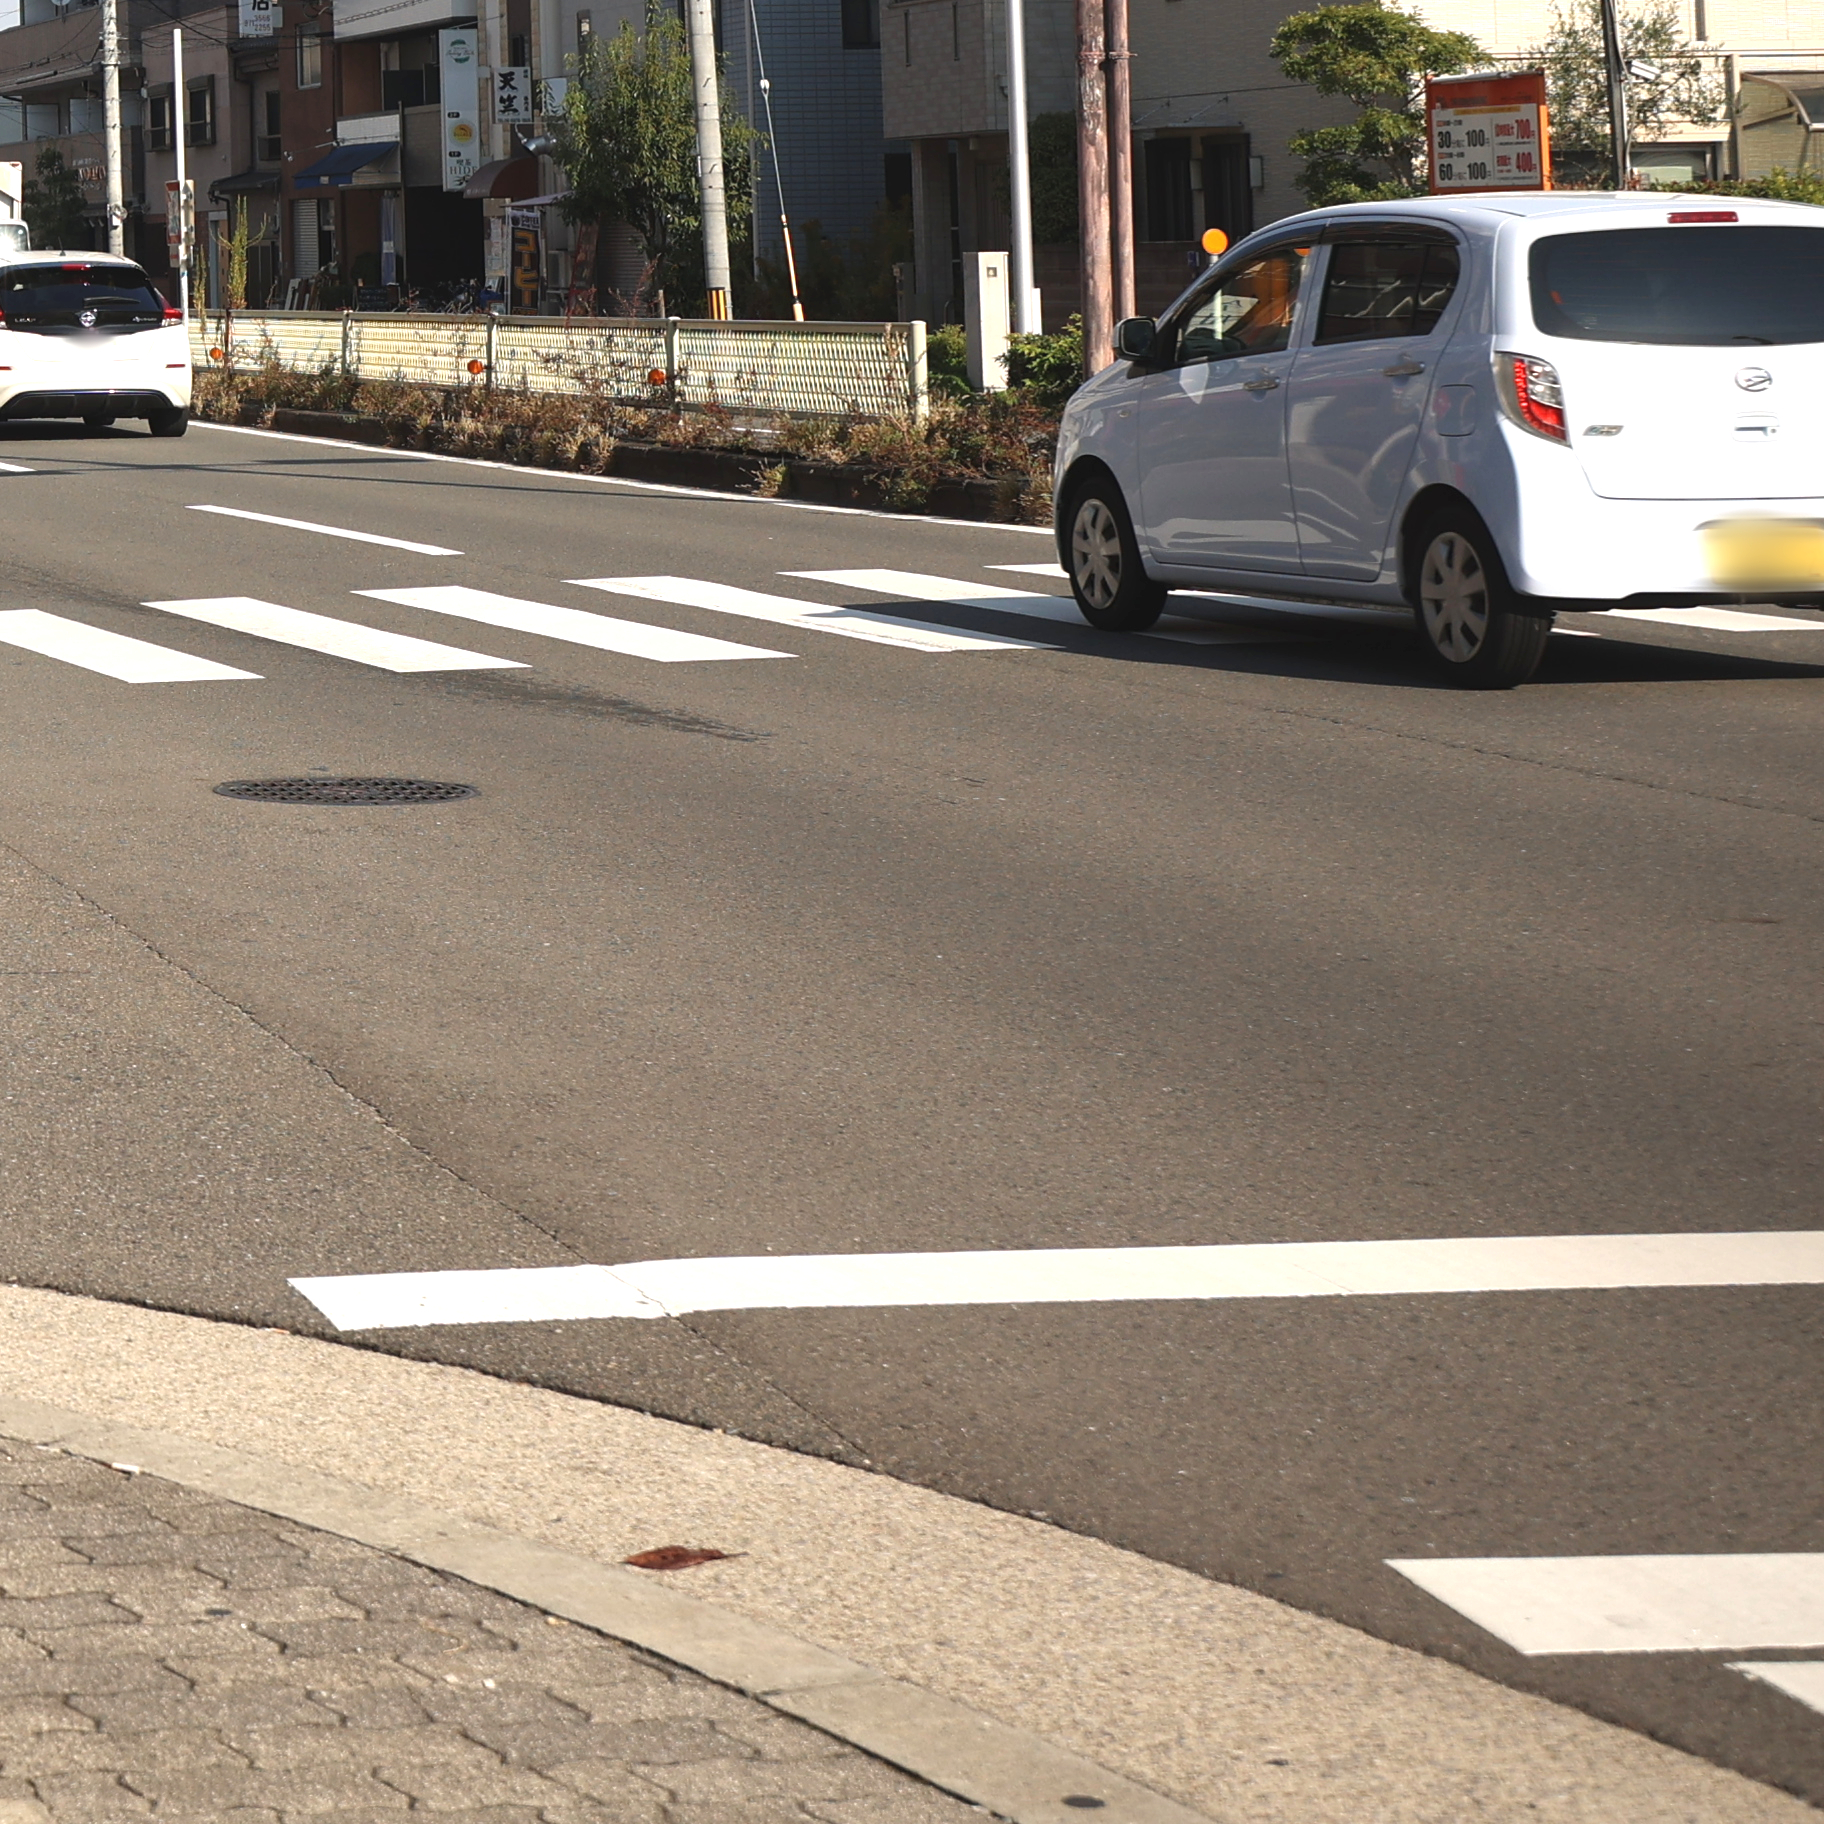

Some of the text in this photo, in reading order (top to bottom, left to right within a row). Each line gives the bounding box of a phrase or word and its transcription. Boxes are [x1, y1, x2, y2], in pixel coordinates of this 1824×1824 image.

[498, 71, 520, 116] 天竺
[514, 230, 538, 306] コーヒー
